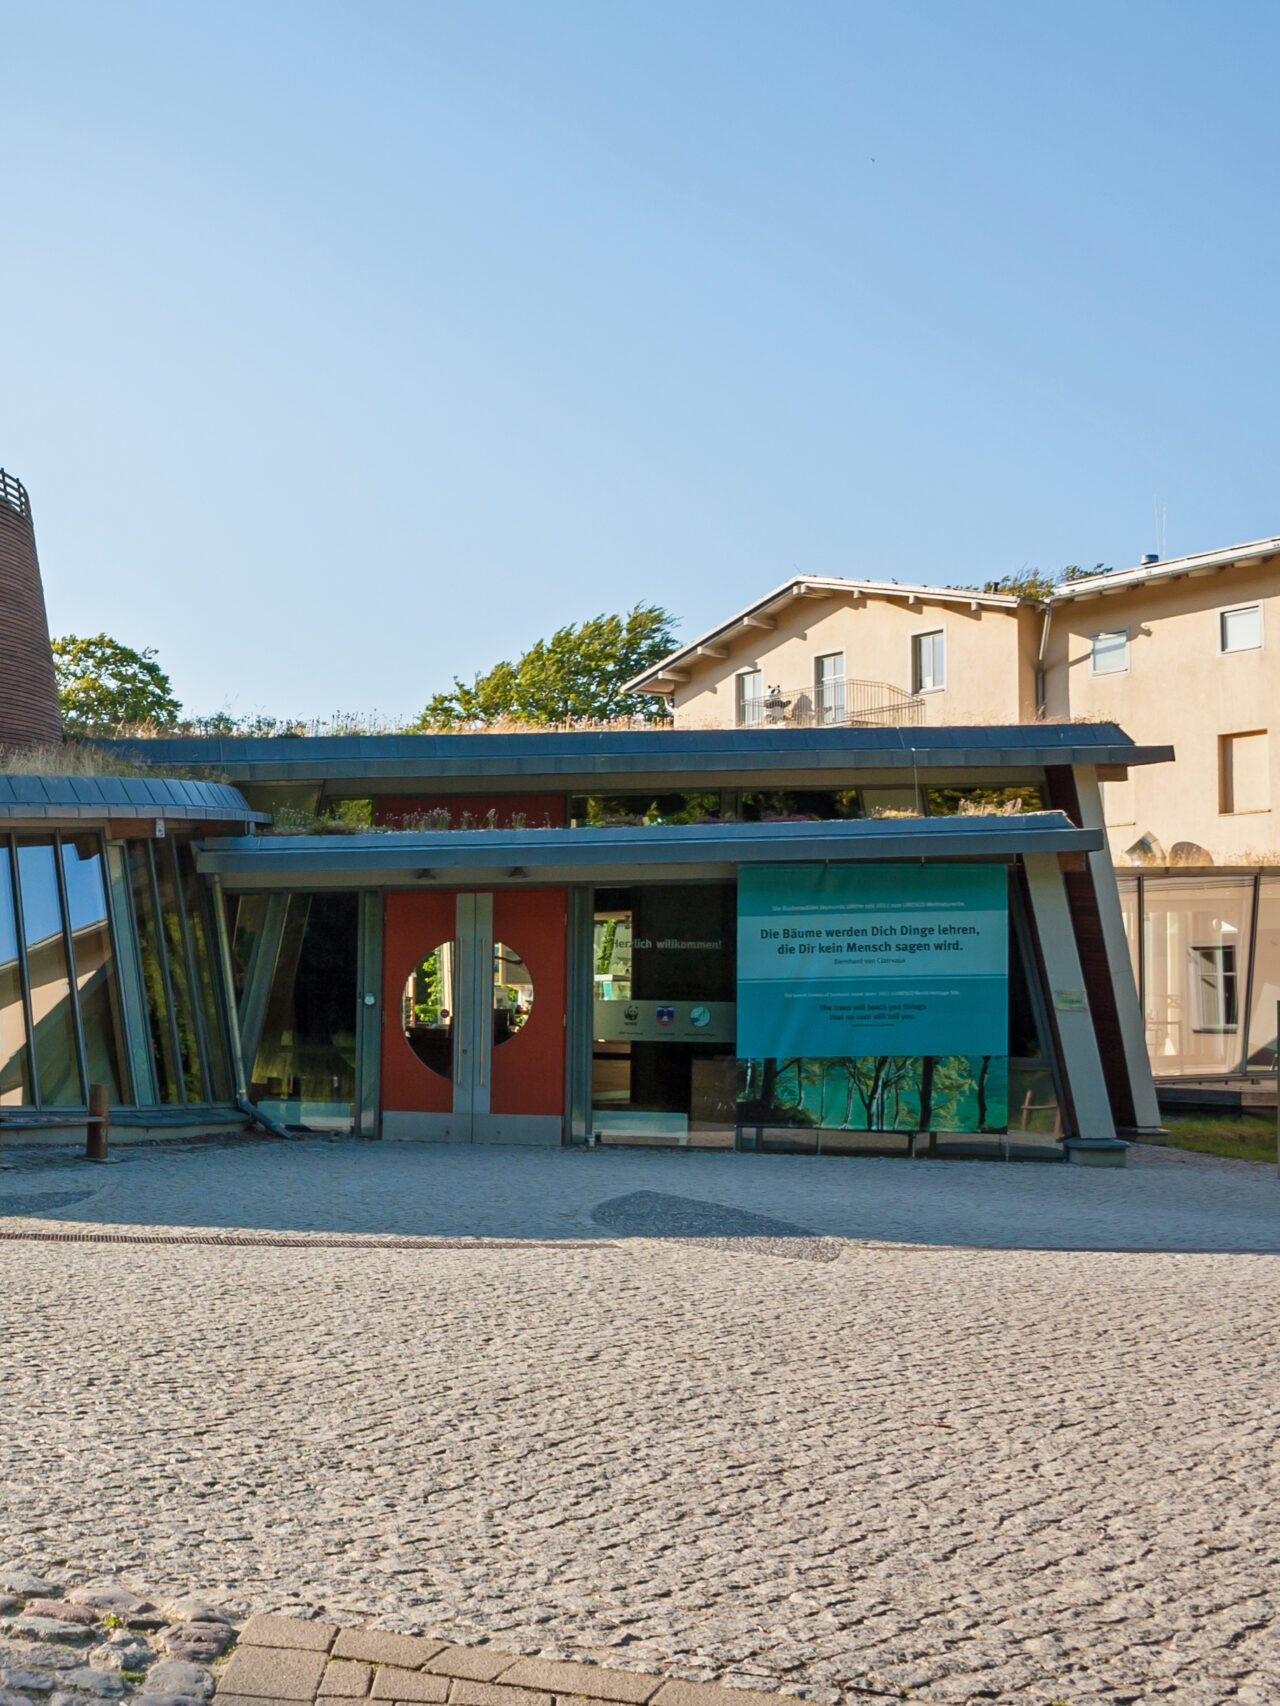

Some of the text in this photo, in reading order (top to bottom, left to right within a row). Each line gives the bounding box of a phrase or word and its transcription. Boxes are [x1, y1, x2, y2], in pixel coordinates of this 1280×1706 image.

[760, 924, 980, 939] Die Bäume werden Dich Dinge lehren,
[655, 938, 722, 949] willkommen!
[777, 940, 964, 954] die Dir kein Mensch sagen wird.
